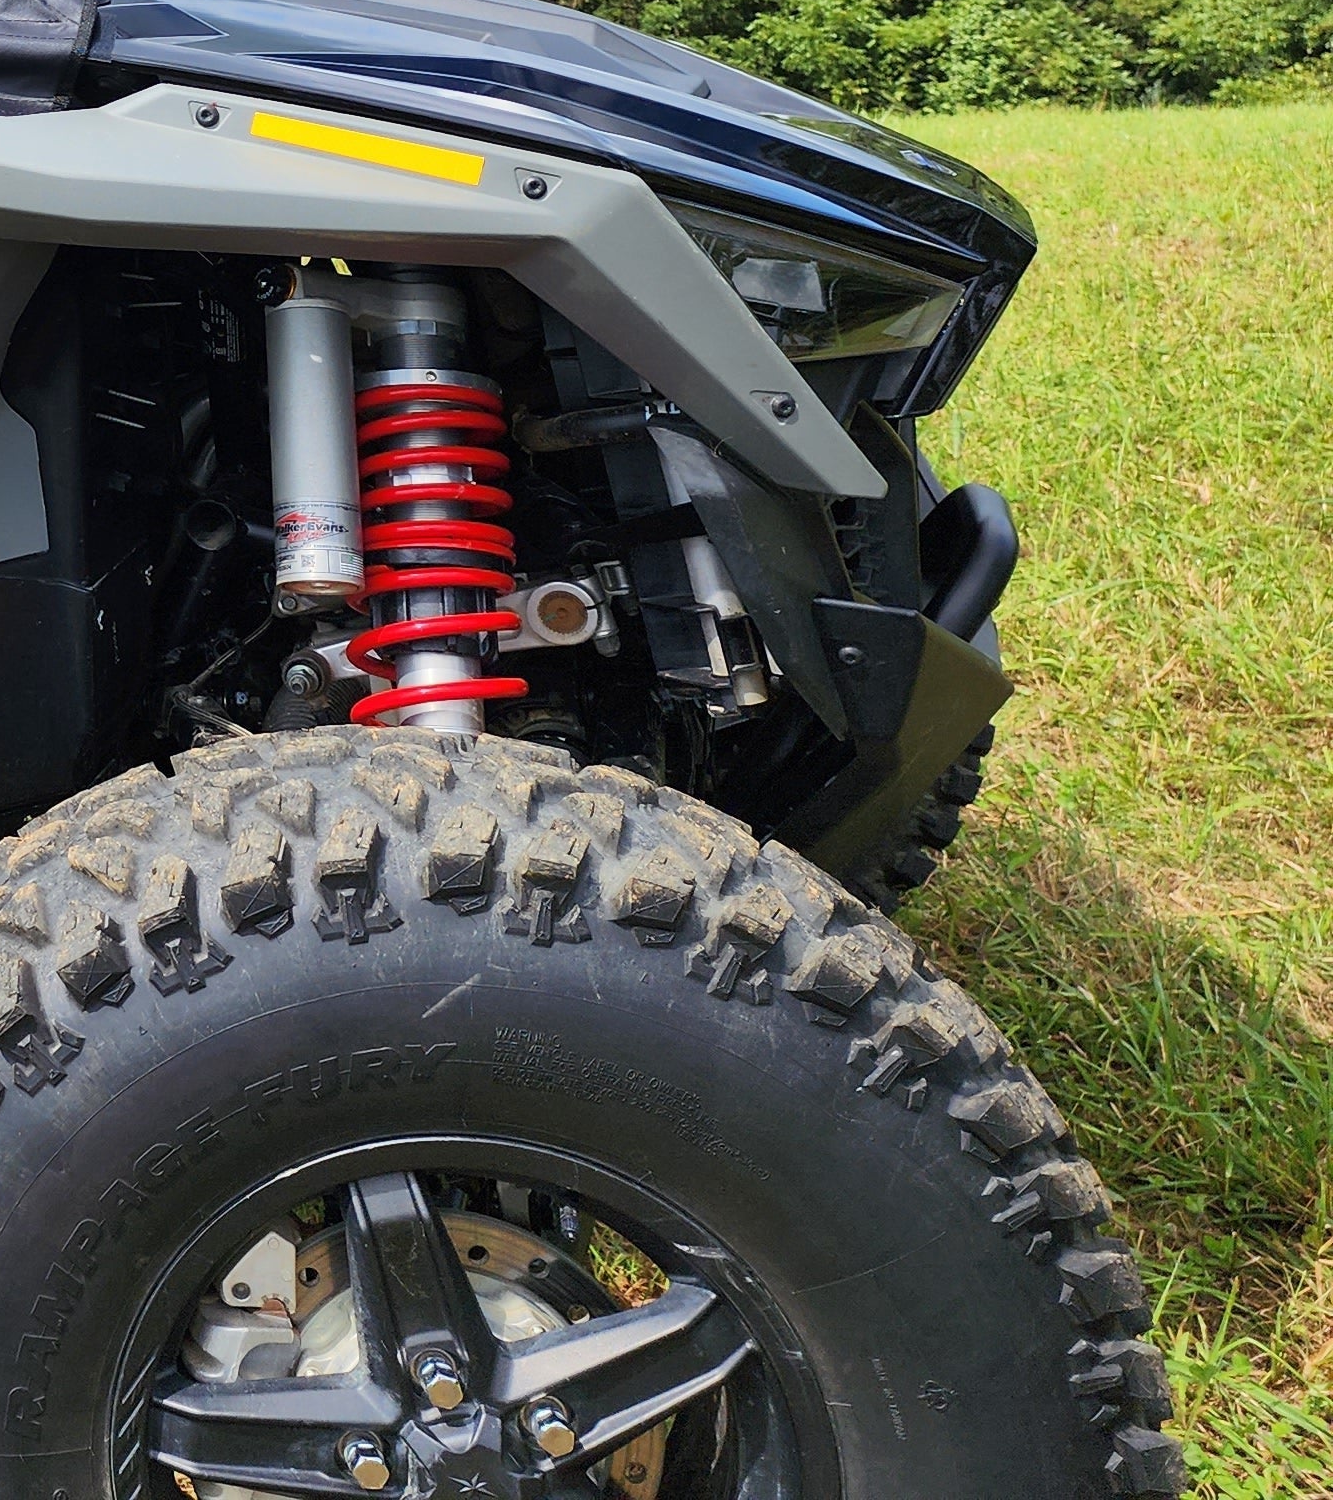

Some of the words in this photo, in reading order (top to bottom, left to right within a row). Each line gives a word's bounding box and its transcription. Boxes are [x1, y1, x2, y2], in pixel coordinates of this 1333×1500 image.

[307, 522, 345, 533] Evans
[2, 1105, 223, 1442] RAMPAGE
[243, 1041, 458, 1123] FURY
